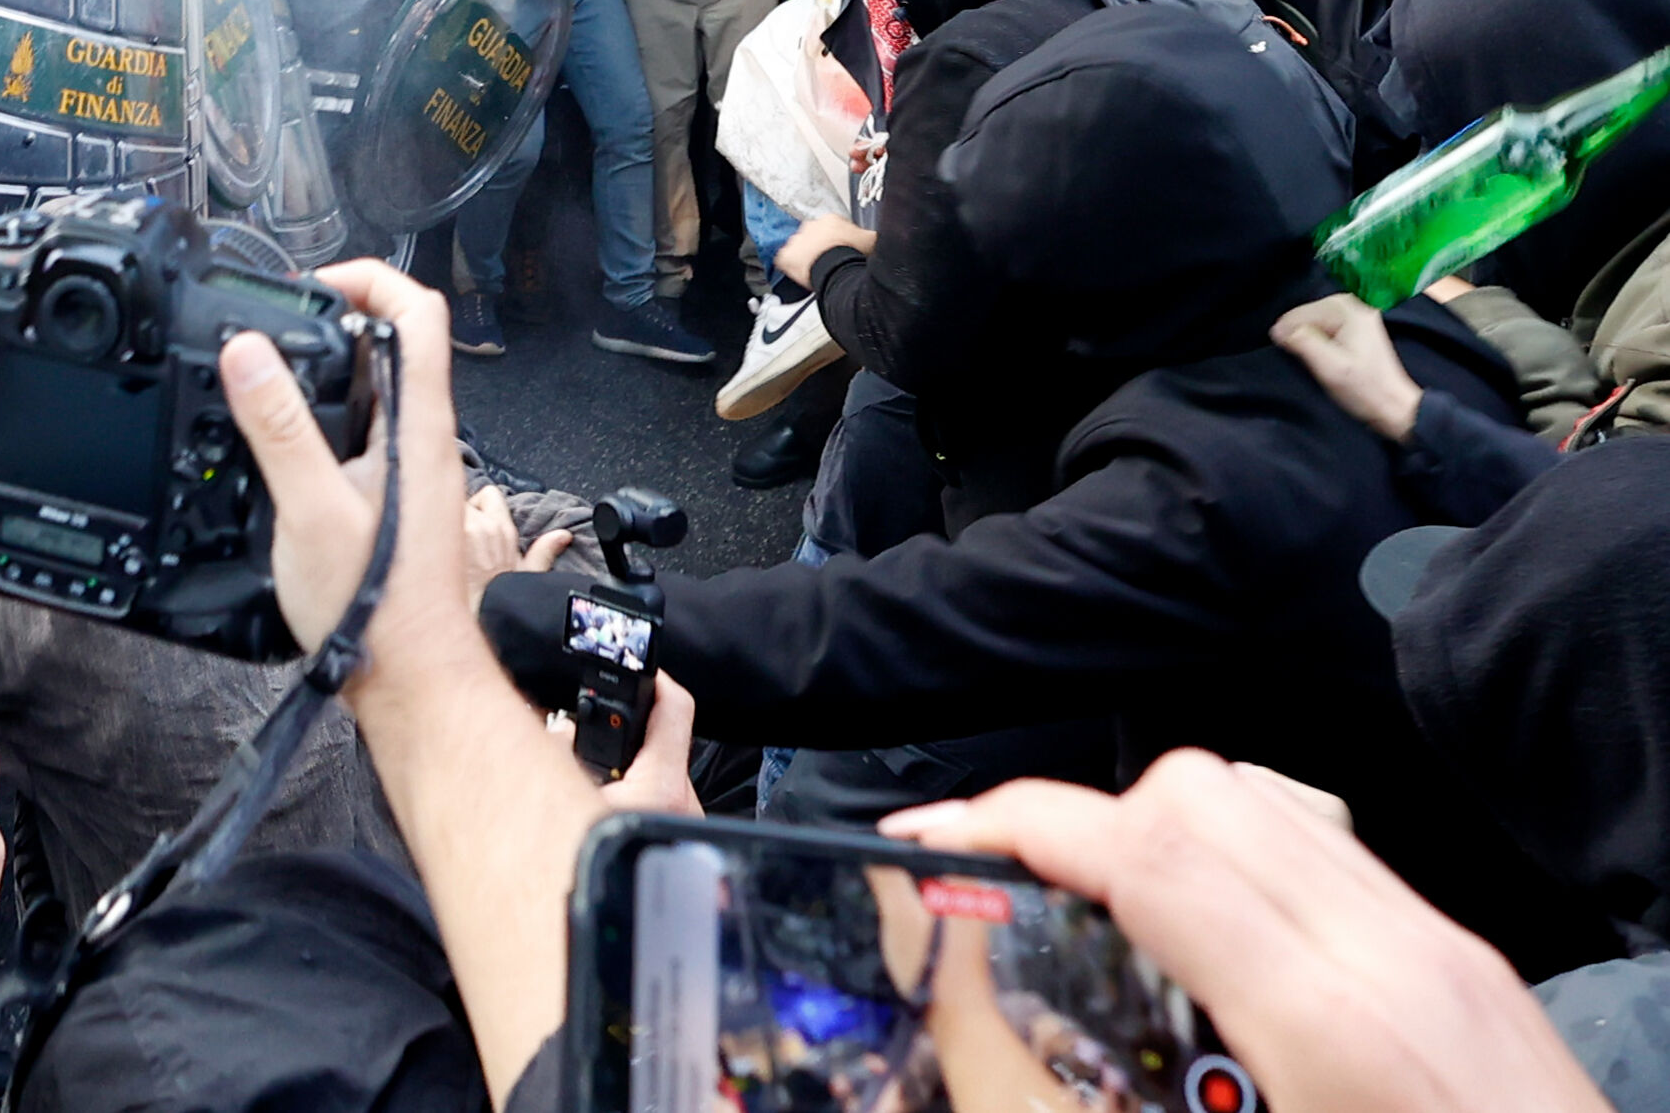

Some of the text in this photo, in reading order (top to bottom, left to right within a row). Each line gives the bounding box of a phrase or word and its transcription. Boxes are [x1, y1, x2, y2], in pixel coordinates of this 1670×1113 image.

[66, 37, 168, 78] GUARDIA
[468, 17, 534, 93] GUARDIA
[105, 75, 124, 96] di
[58, 88, 163, 128] FINANZA
[423, 88, 490, 159] FINANZA
